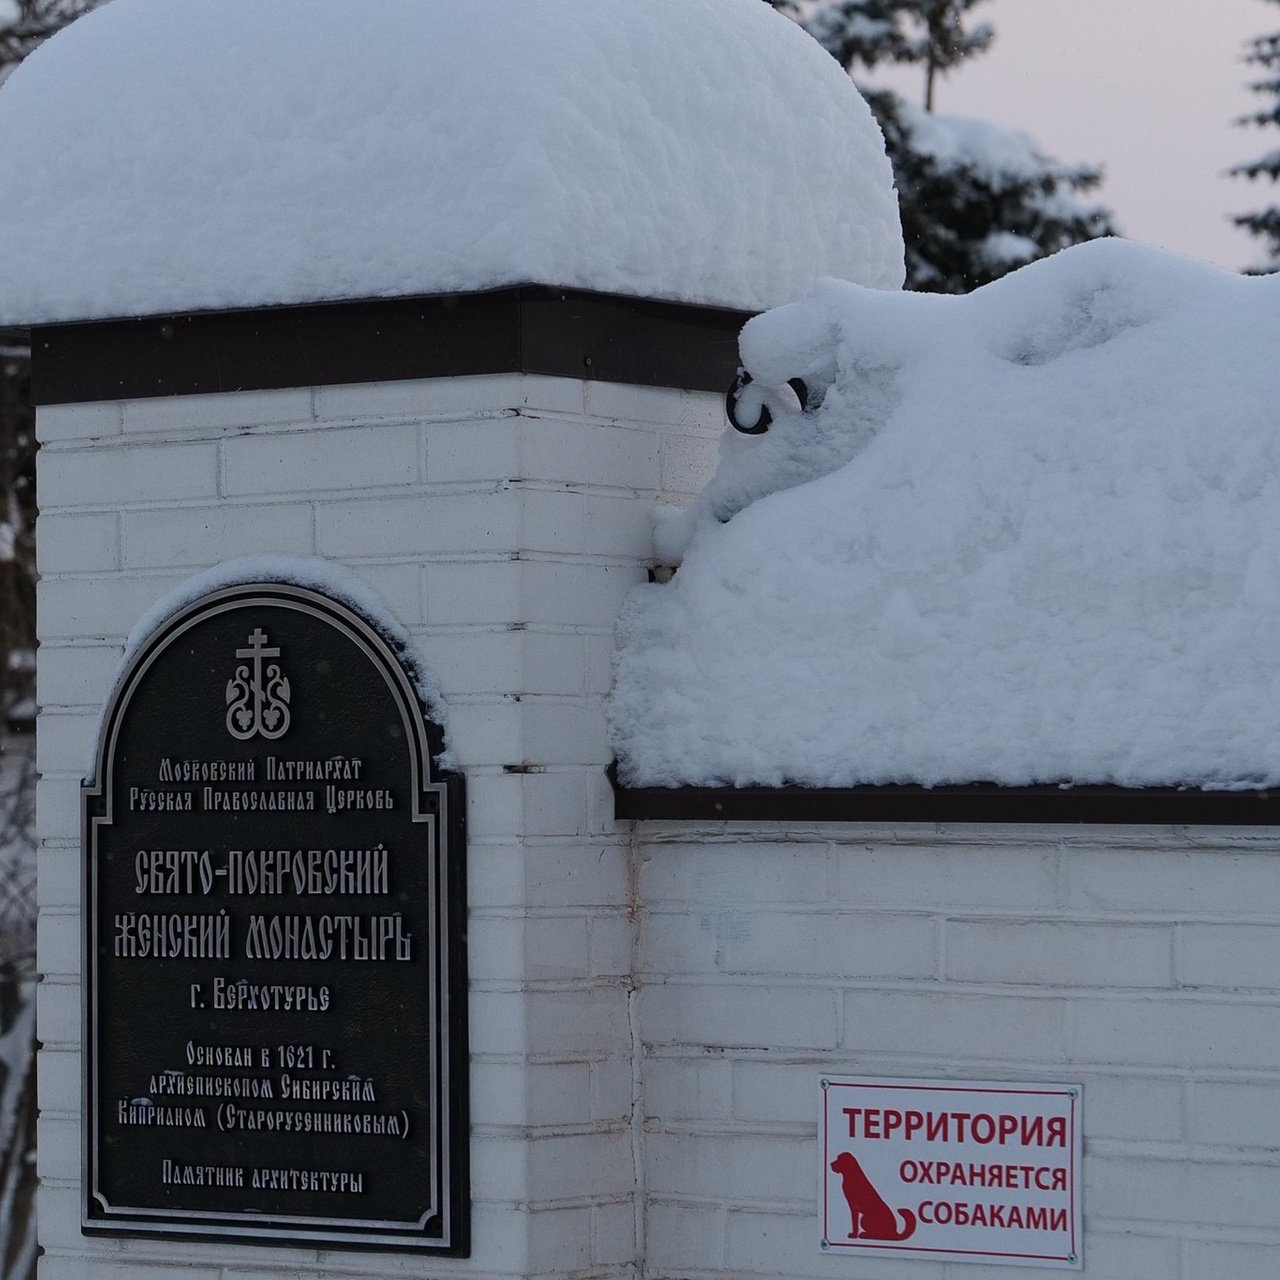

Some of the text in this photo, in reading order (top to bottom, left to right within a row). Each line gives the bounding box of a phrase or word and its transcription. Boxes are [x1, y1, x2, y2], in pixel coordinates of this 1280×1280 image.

[159, 757, 362, 781] Московский Патриархат
[130, 785, 393, 813] Русская Православная Церковь
[135, 844, 388, 894] СВЯТО-ПОКРОВСКИЙ
[115, 909, 410, 960] ЖЕНСКИЙ МОНАСТЫРЬ
[214, 978, 330, 1011] Верхотурье
[186, 1041, 252, 1067] Основан
[278, 1046, 313, 1068] 1621
[149, 1074, 375, 1102] архиепископом Сибирским
[843, 1108, 1066, 1147] ТЕРРИТОРИЯ
[162, 1160, 362, 1193] Памятник архитектуры
[899, 1160, 1067, 1191] ОХРАНЯЕТСЯ
[918, 1201, 1067, 1232] СОБАКАМИ
